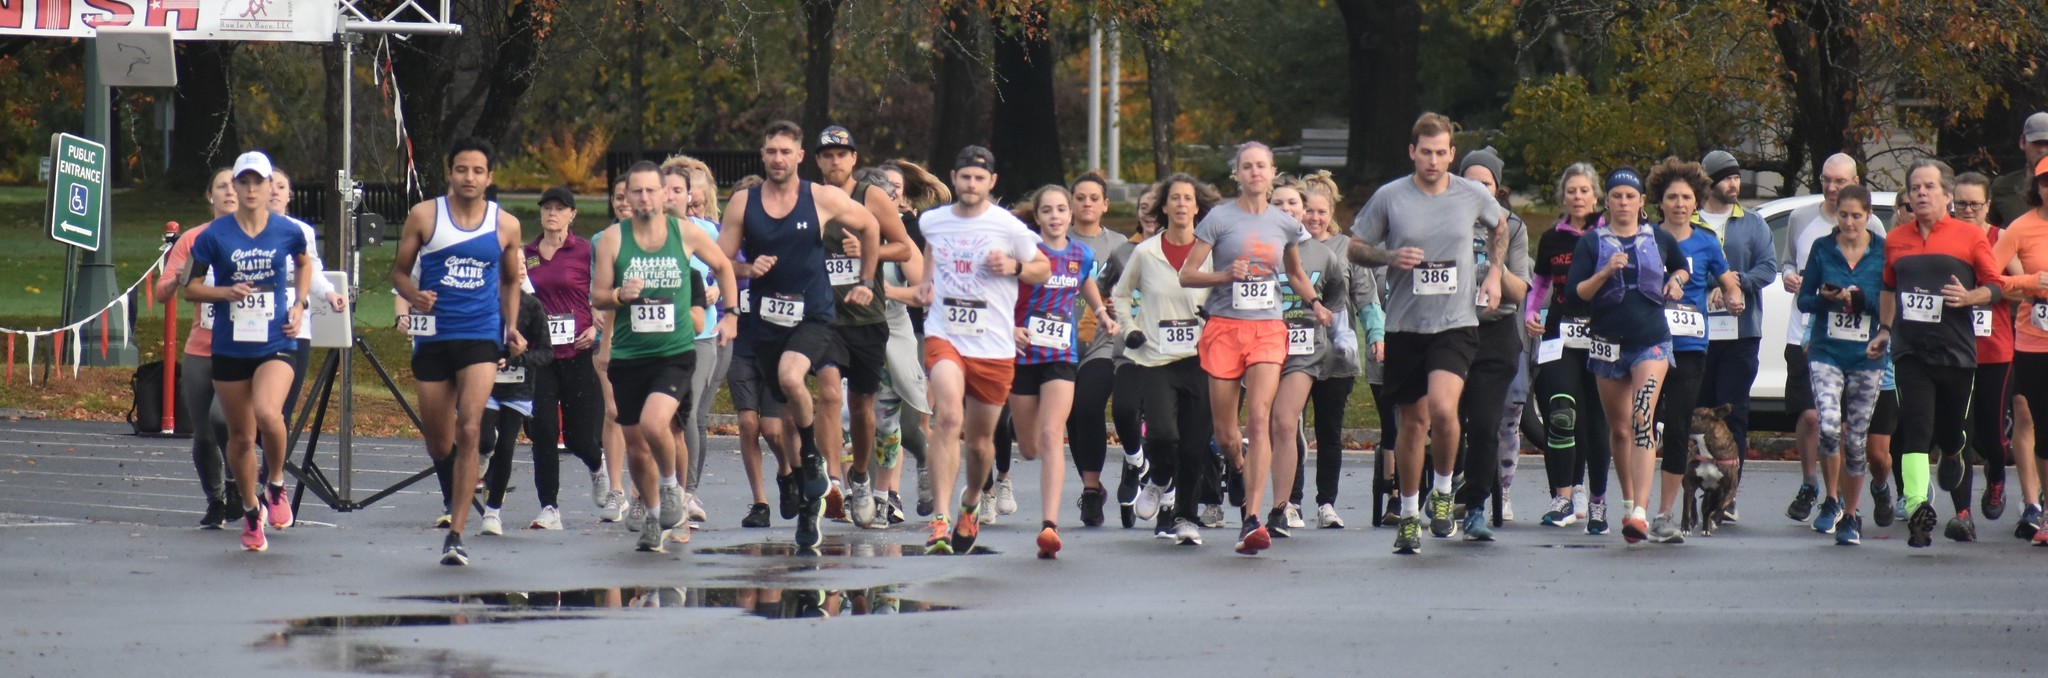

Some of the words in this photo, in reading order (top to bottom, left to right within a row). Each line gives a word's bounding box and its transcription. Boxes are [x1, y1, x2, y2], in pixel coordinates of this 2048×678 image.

[276, 22, 292, 30] LLC
[68, 144, 96, 164] PUBLIC
[60, 160, 101, 184] ENTRANCE
[231, 248, 277, 262] Central
[444, 255, 491, 268] Central
[237, 258, 272, 271] MAINE
[826, 260, 853, 274] 384
[953, 260, 973, 274] 10K
[231, 269, 275, 281] Striders
[448, 265, 483, 279] MAINE
[623, 270, 665, 280] SABATTUS
[666, 270, 682, 279] REC
[1421, 269, 1450, 284] 386
[440, 275, 485, 289] Striders
[660, 278, 682, 288] CLUB
[1047, 274, 1078, 287] kuten
[1240, 283, 1268, 297] 382
[237, 294, 266, 309] 394
[768, 301, 795, 316] 372
[1906, 294, 1934, 310] 373
[637, 306, 666, 320] 318
[948, 308, 977, 324] 320
[1672, 311, 1697, 326] 331
[550, 321, 566, 334] 71
[1036, 320, 1065, 338] 344
[1166, 328, 1195, 342] 385
[1288, 330, 1307, 343] 23
[1590, 341, 1612, 357] 398
